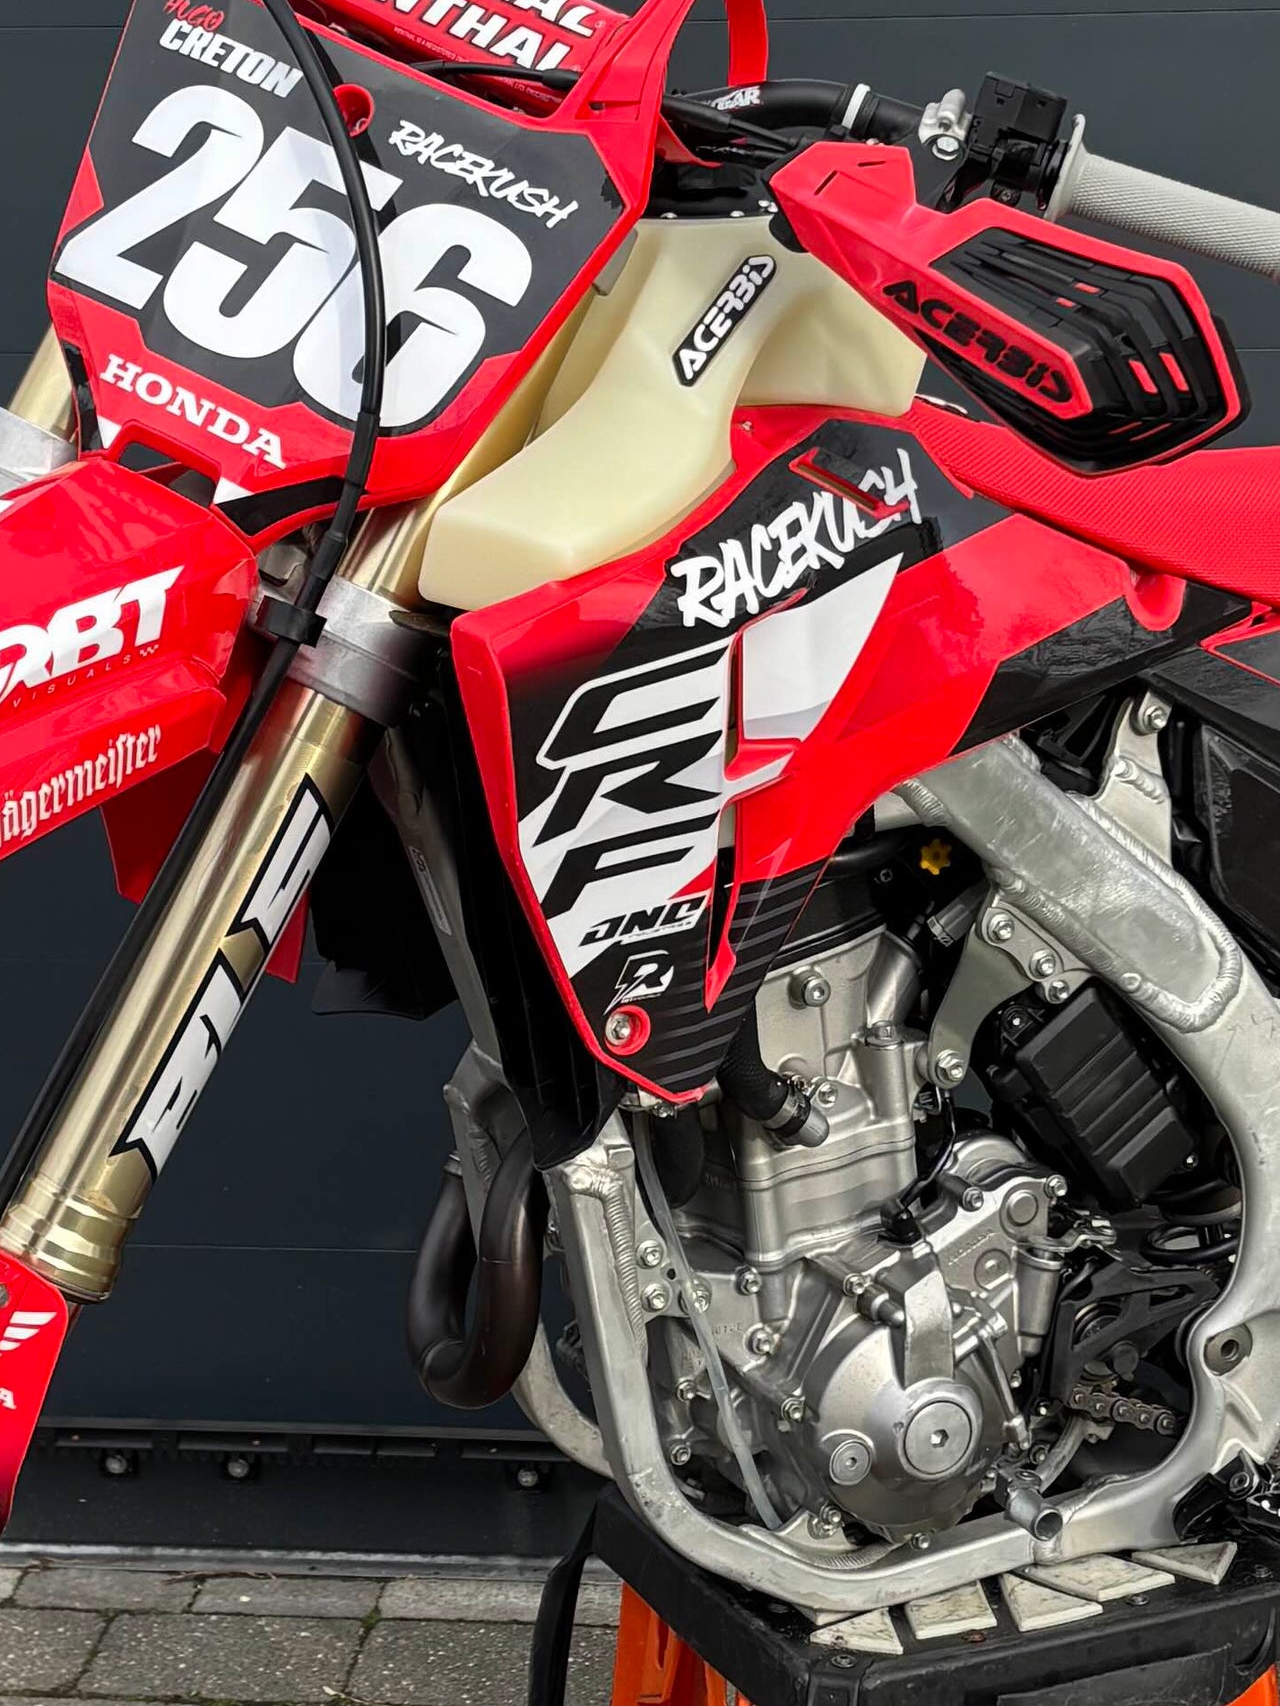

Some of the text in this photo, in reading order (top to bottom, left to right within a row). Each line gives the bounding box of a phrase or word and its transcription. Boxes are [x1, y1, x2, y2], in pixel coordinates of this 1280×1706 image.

[160, 18, 304, 98] CRETON
[388, 119, 579, 229] RACEKUSH
[55, 85, 533, 427] 256
[678, 255, 775, 381] ACERBIS
[883, 281, 1075, 404] ACERBIS
[101, 353, 287, 469] HONDA
[13, 653, 133, 709] VISUALS
